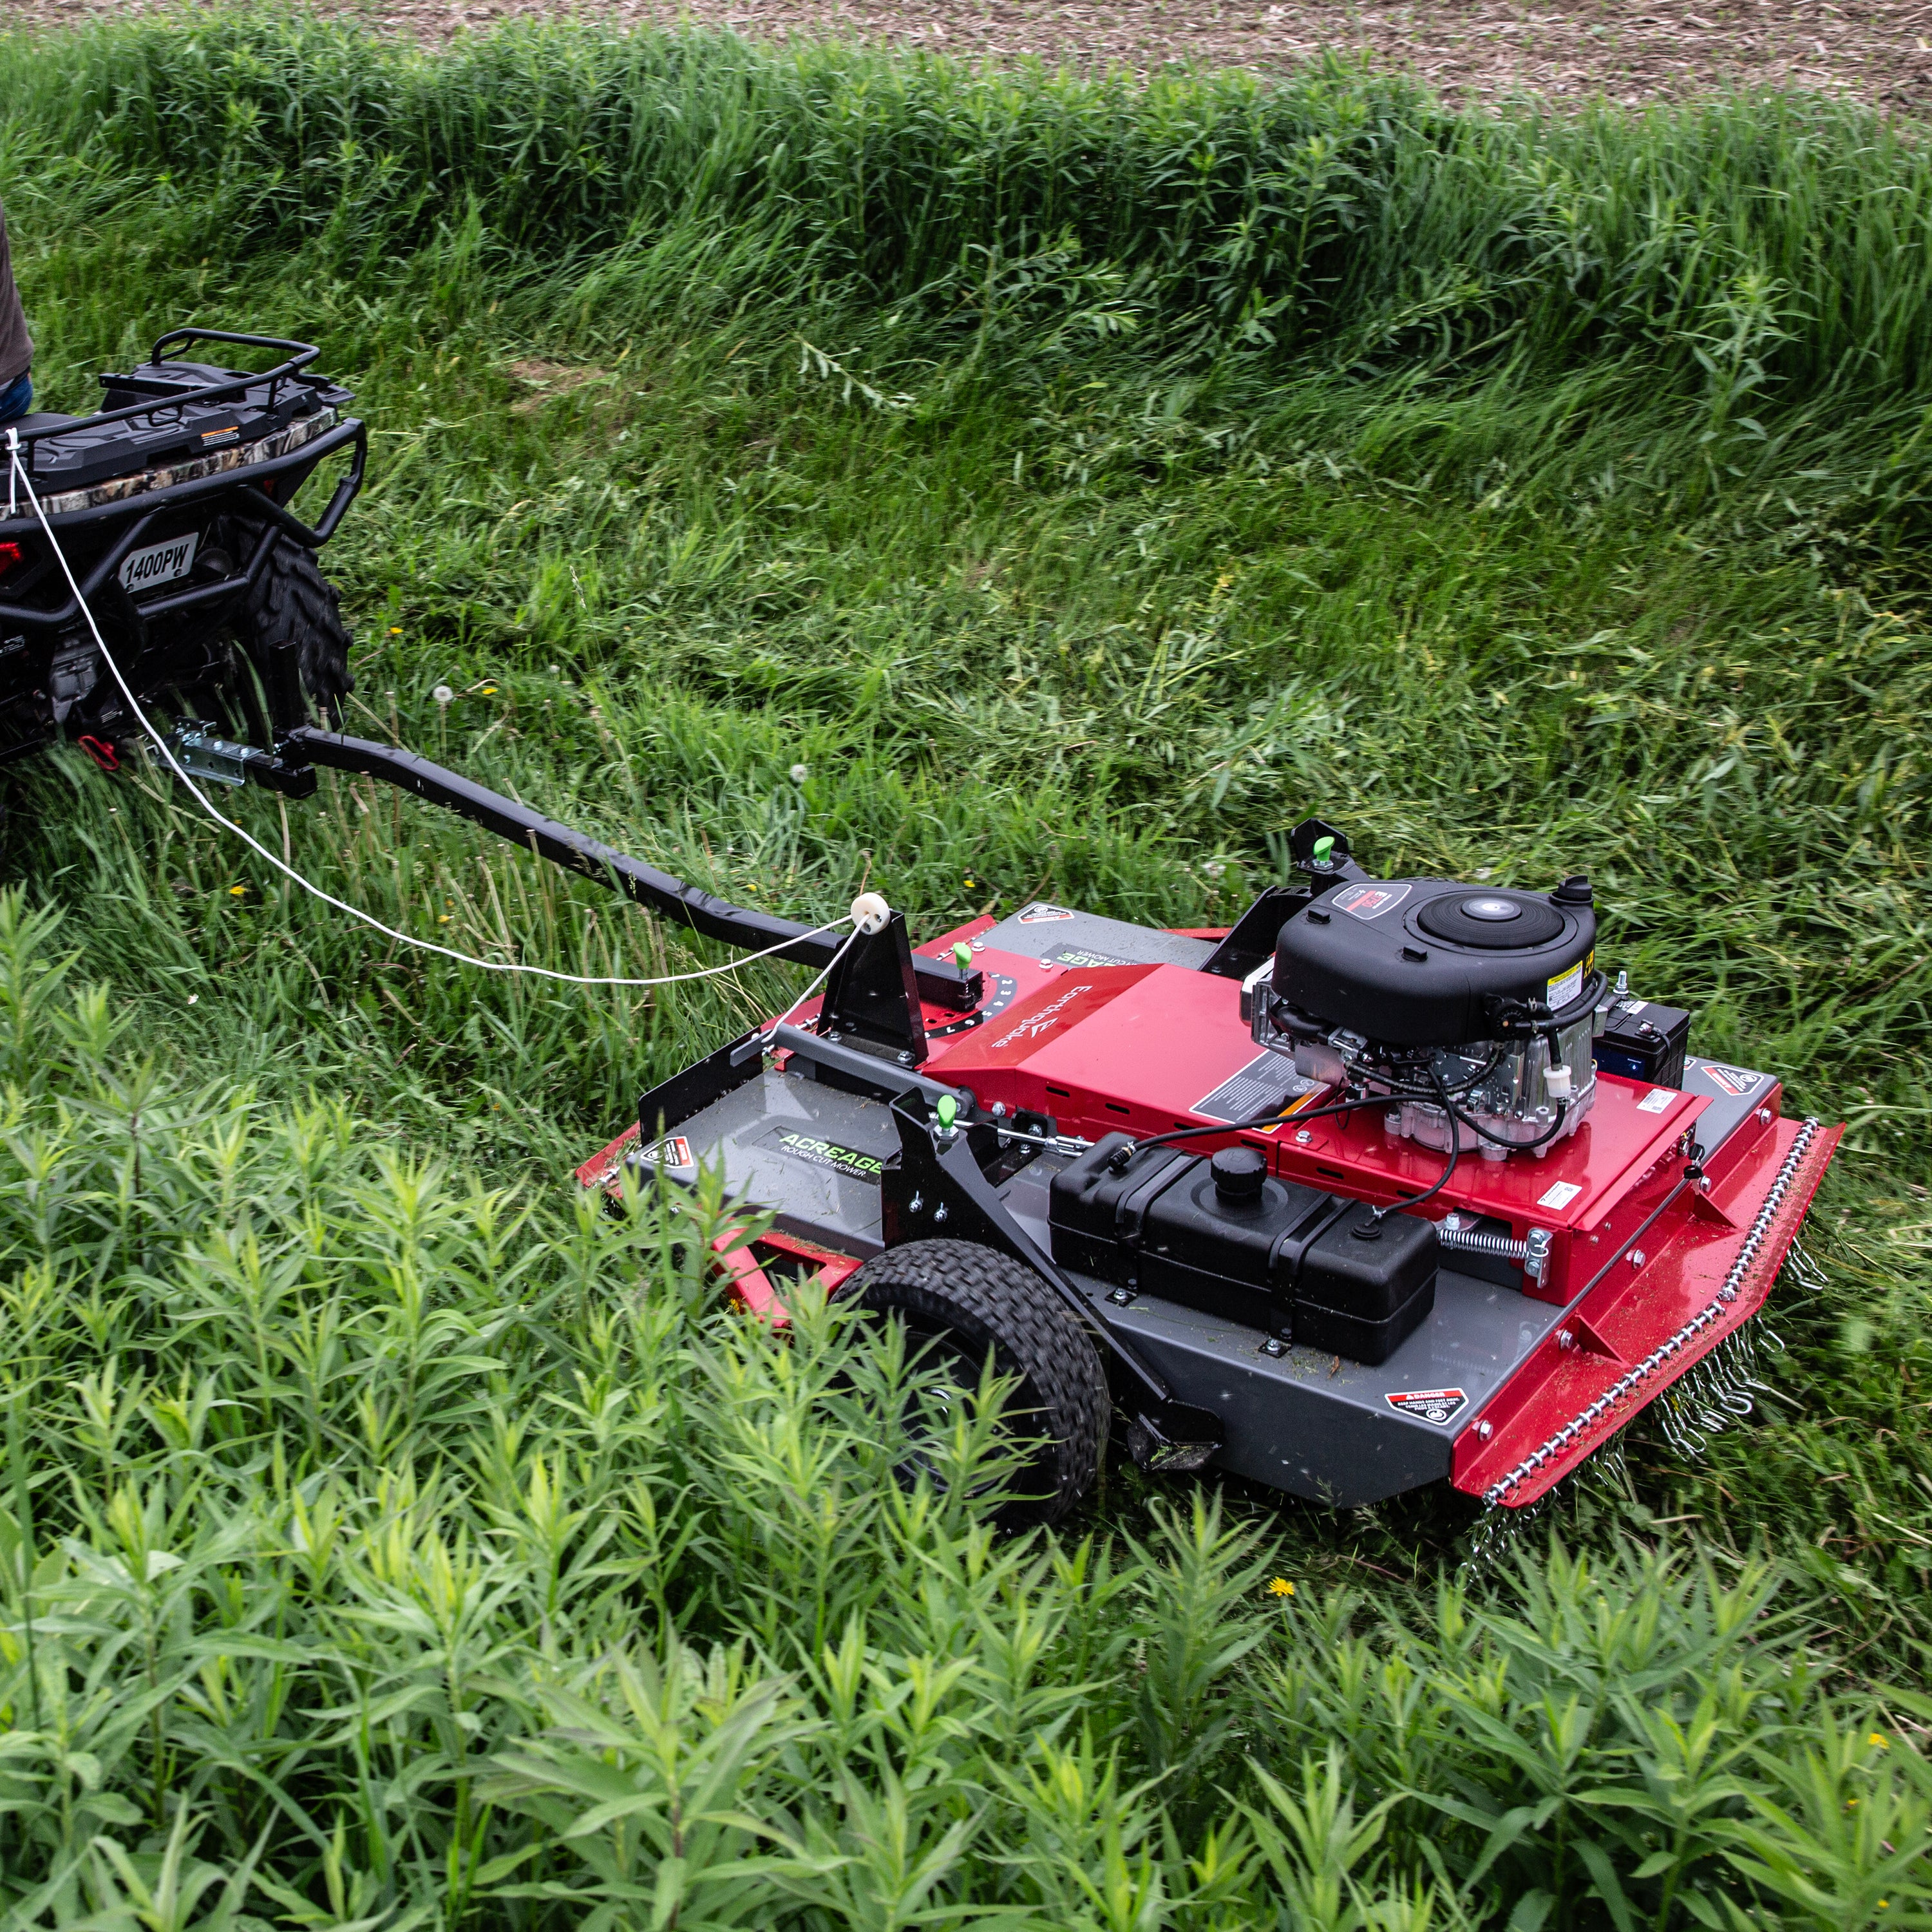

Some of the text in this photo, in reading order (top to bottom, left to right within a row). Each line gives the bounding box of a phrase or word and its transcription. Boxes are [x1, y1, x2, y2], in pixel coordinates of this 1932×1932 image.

[126, 543, 189, 584] 1400PW
[1077, 950, 1110, 962] MOWER
[990, 985, 1093, 1048] Earthquake
[779, 1133, 883, 1175] ACREAGE
[781, 1145, 866, 1177] ROUGH CUT MOWER
